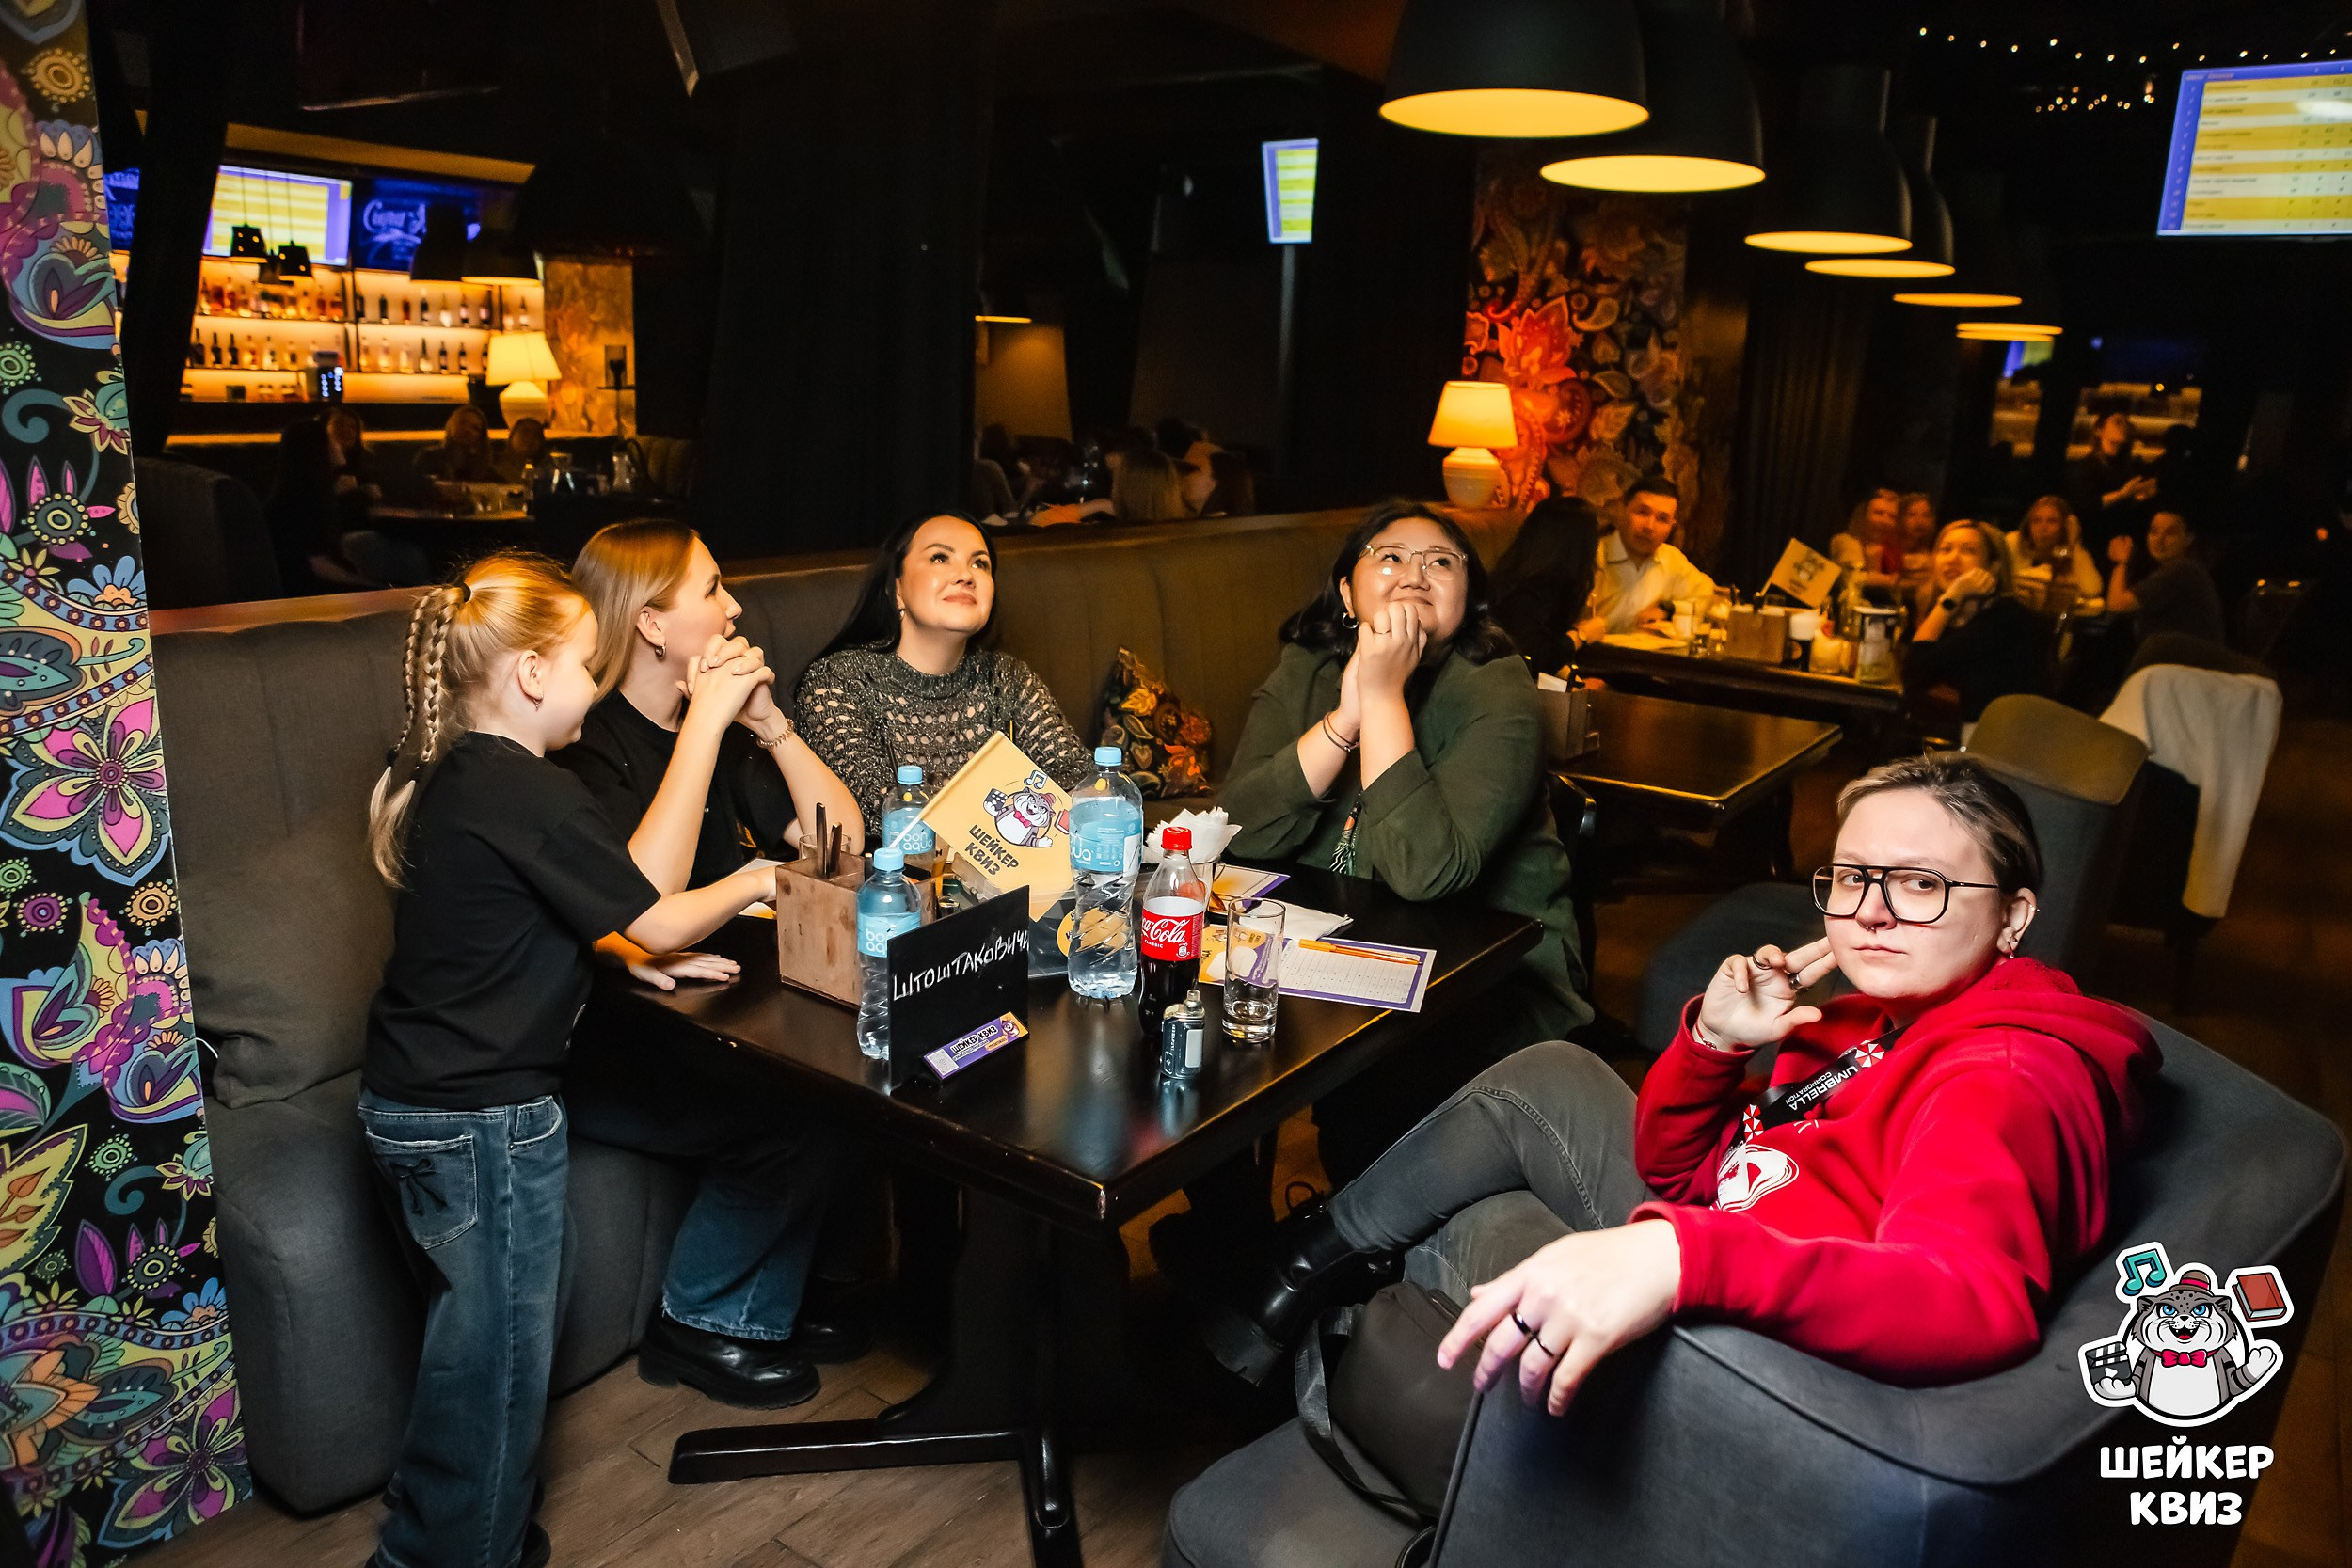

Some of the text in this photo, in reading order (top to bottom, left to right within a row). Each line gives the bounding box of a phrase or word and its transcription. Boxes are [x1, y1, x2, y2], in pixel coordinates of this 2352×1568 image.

[903, 839, 933, 852] aqua
[964, 842, 1001, 876] КВИЗ
[968, 824, 1020, 868] ШЕЙКЕР
[1144, 939, 1164, 949] CLASSIC
[951, 1035, 978, 1053] ШЕЙКЕР
[977, 1025, 997, 1039] КВИЗ
[1785, 1071, 1833, 1105] CORPORATION
[1788, 1065, 1859, 1111] UMBRELLA
